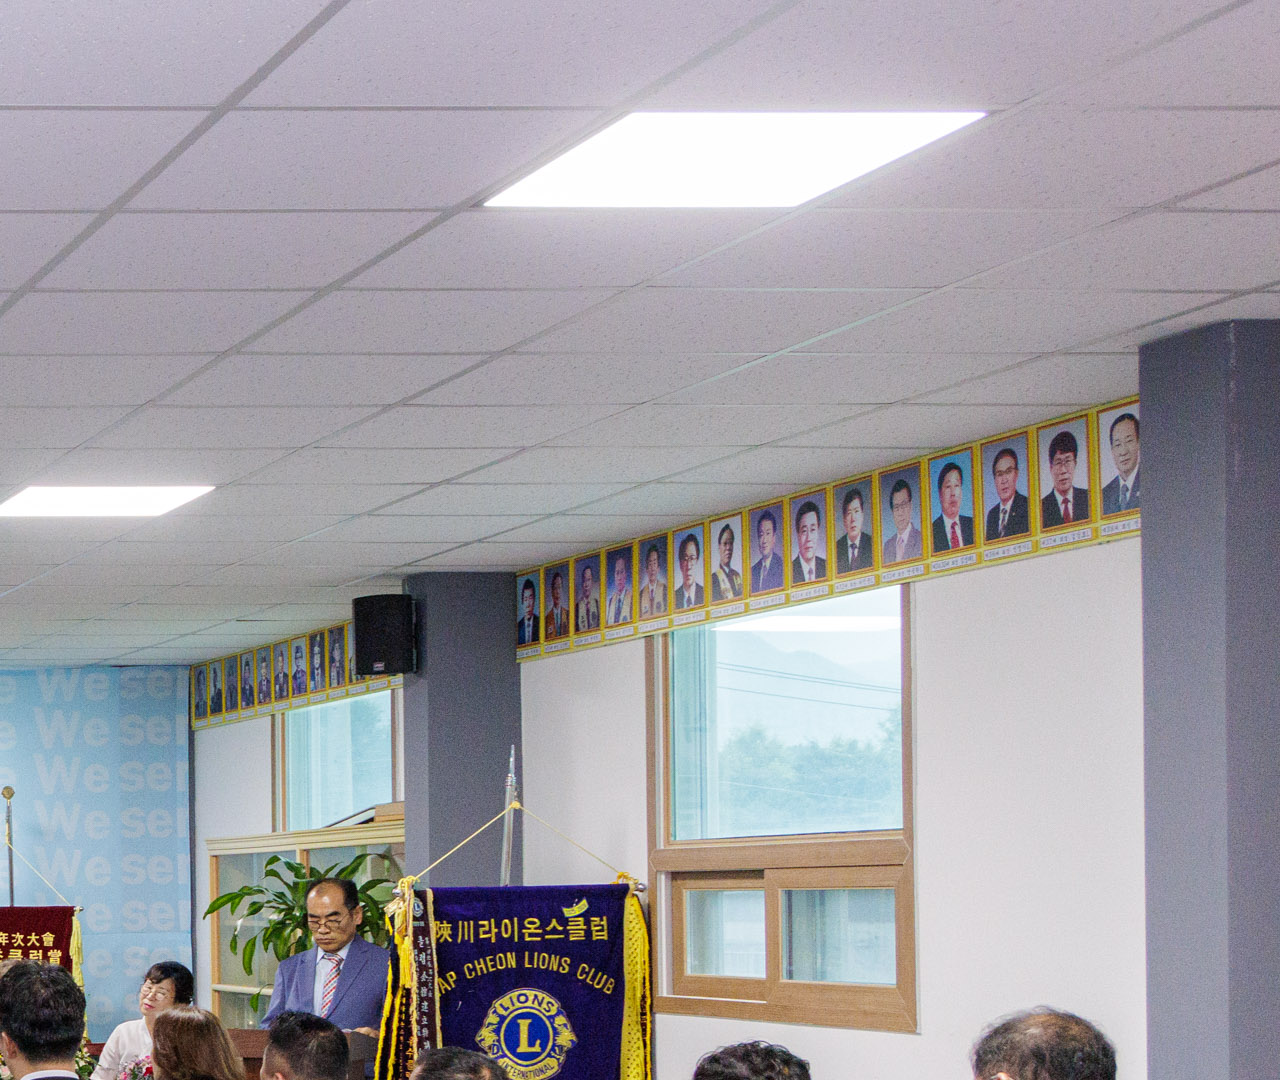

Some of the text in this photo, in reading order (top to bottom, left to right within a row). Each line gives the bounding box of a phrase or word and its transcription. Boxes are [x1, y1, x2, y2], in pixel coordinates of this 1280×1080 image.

[36, 668, 110, 702] We
[34, 706, 110, 749] We
[34, 753, 110, 795] We
[35, 799, 110, 841] We
[35, 846, 112, 887] We
[463, 953, 517, 979] CHEON
[524, 952, 571, 973] LIONS
[577, 963, 615, 995] CLUB
[500, 992, 554, 1012] LIONS
[516, 1018, 541, 1053] L
